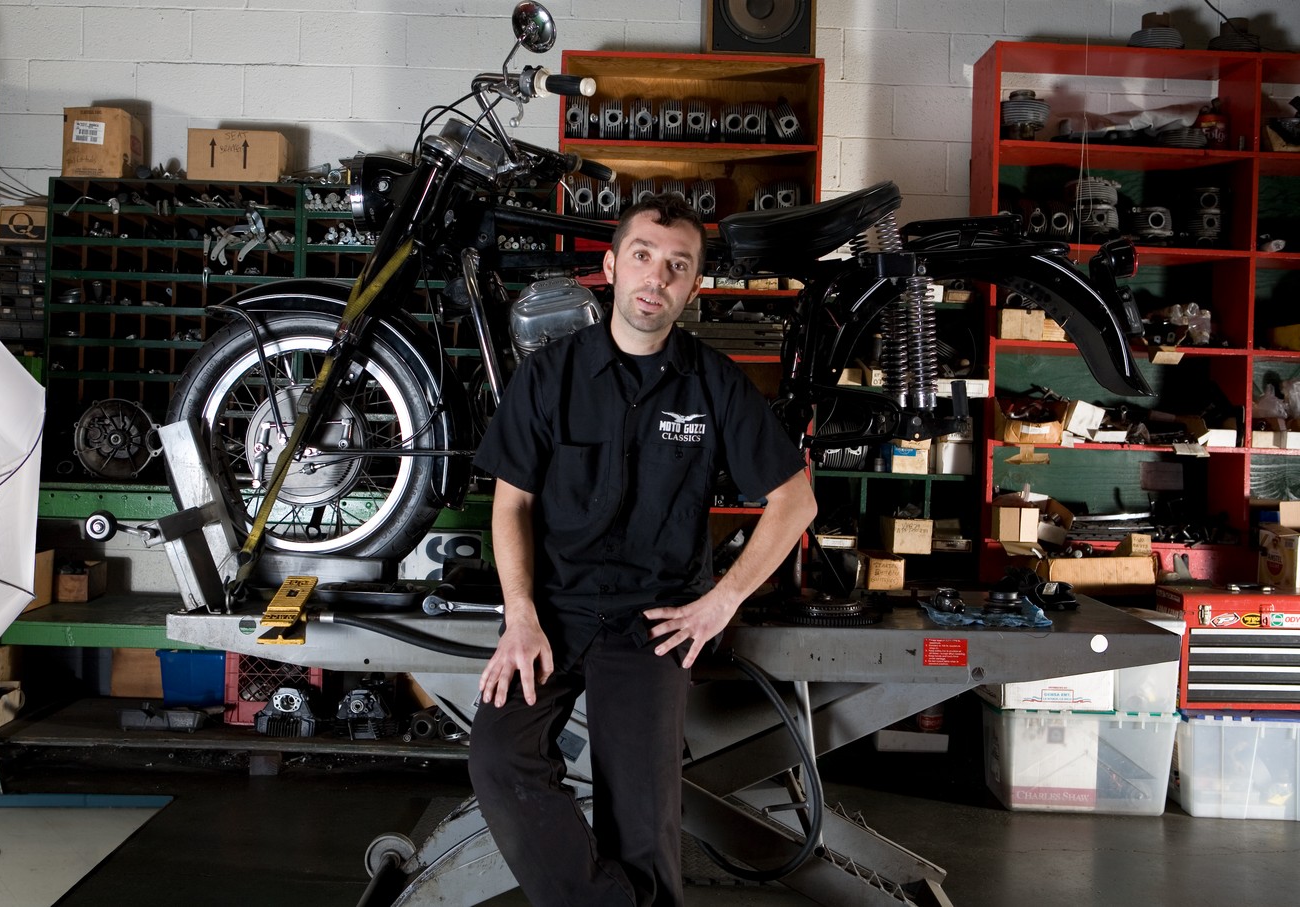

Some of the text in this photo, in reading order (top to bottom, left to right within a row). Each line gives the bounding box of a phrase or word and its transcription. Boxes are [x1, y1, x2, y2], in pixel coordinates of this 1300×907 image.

[8, 212, 39, 239] Q
[659, 420, 706, 434] MOTO GUZZI
[661, 432, 701, 442] CLASSICS
[1016, 791, 1090, 802] CHARLES SHAW
